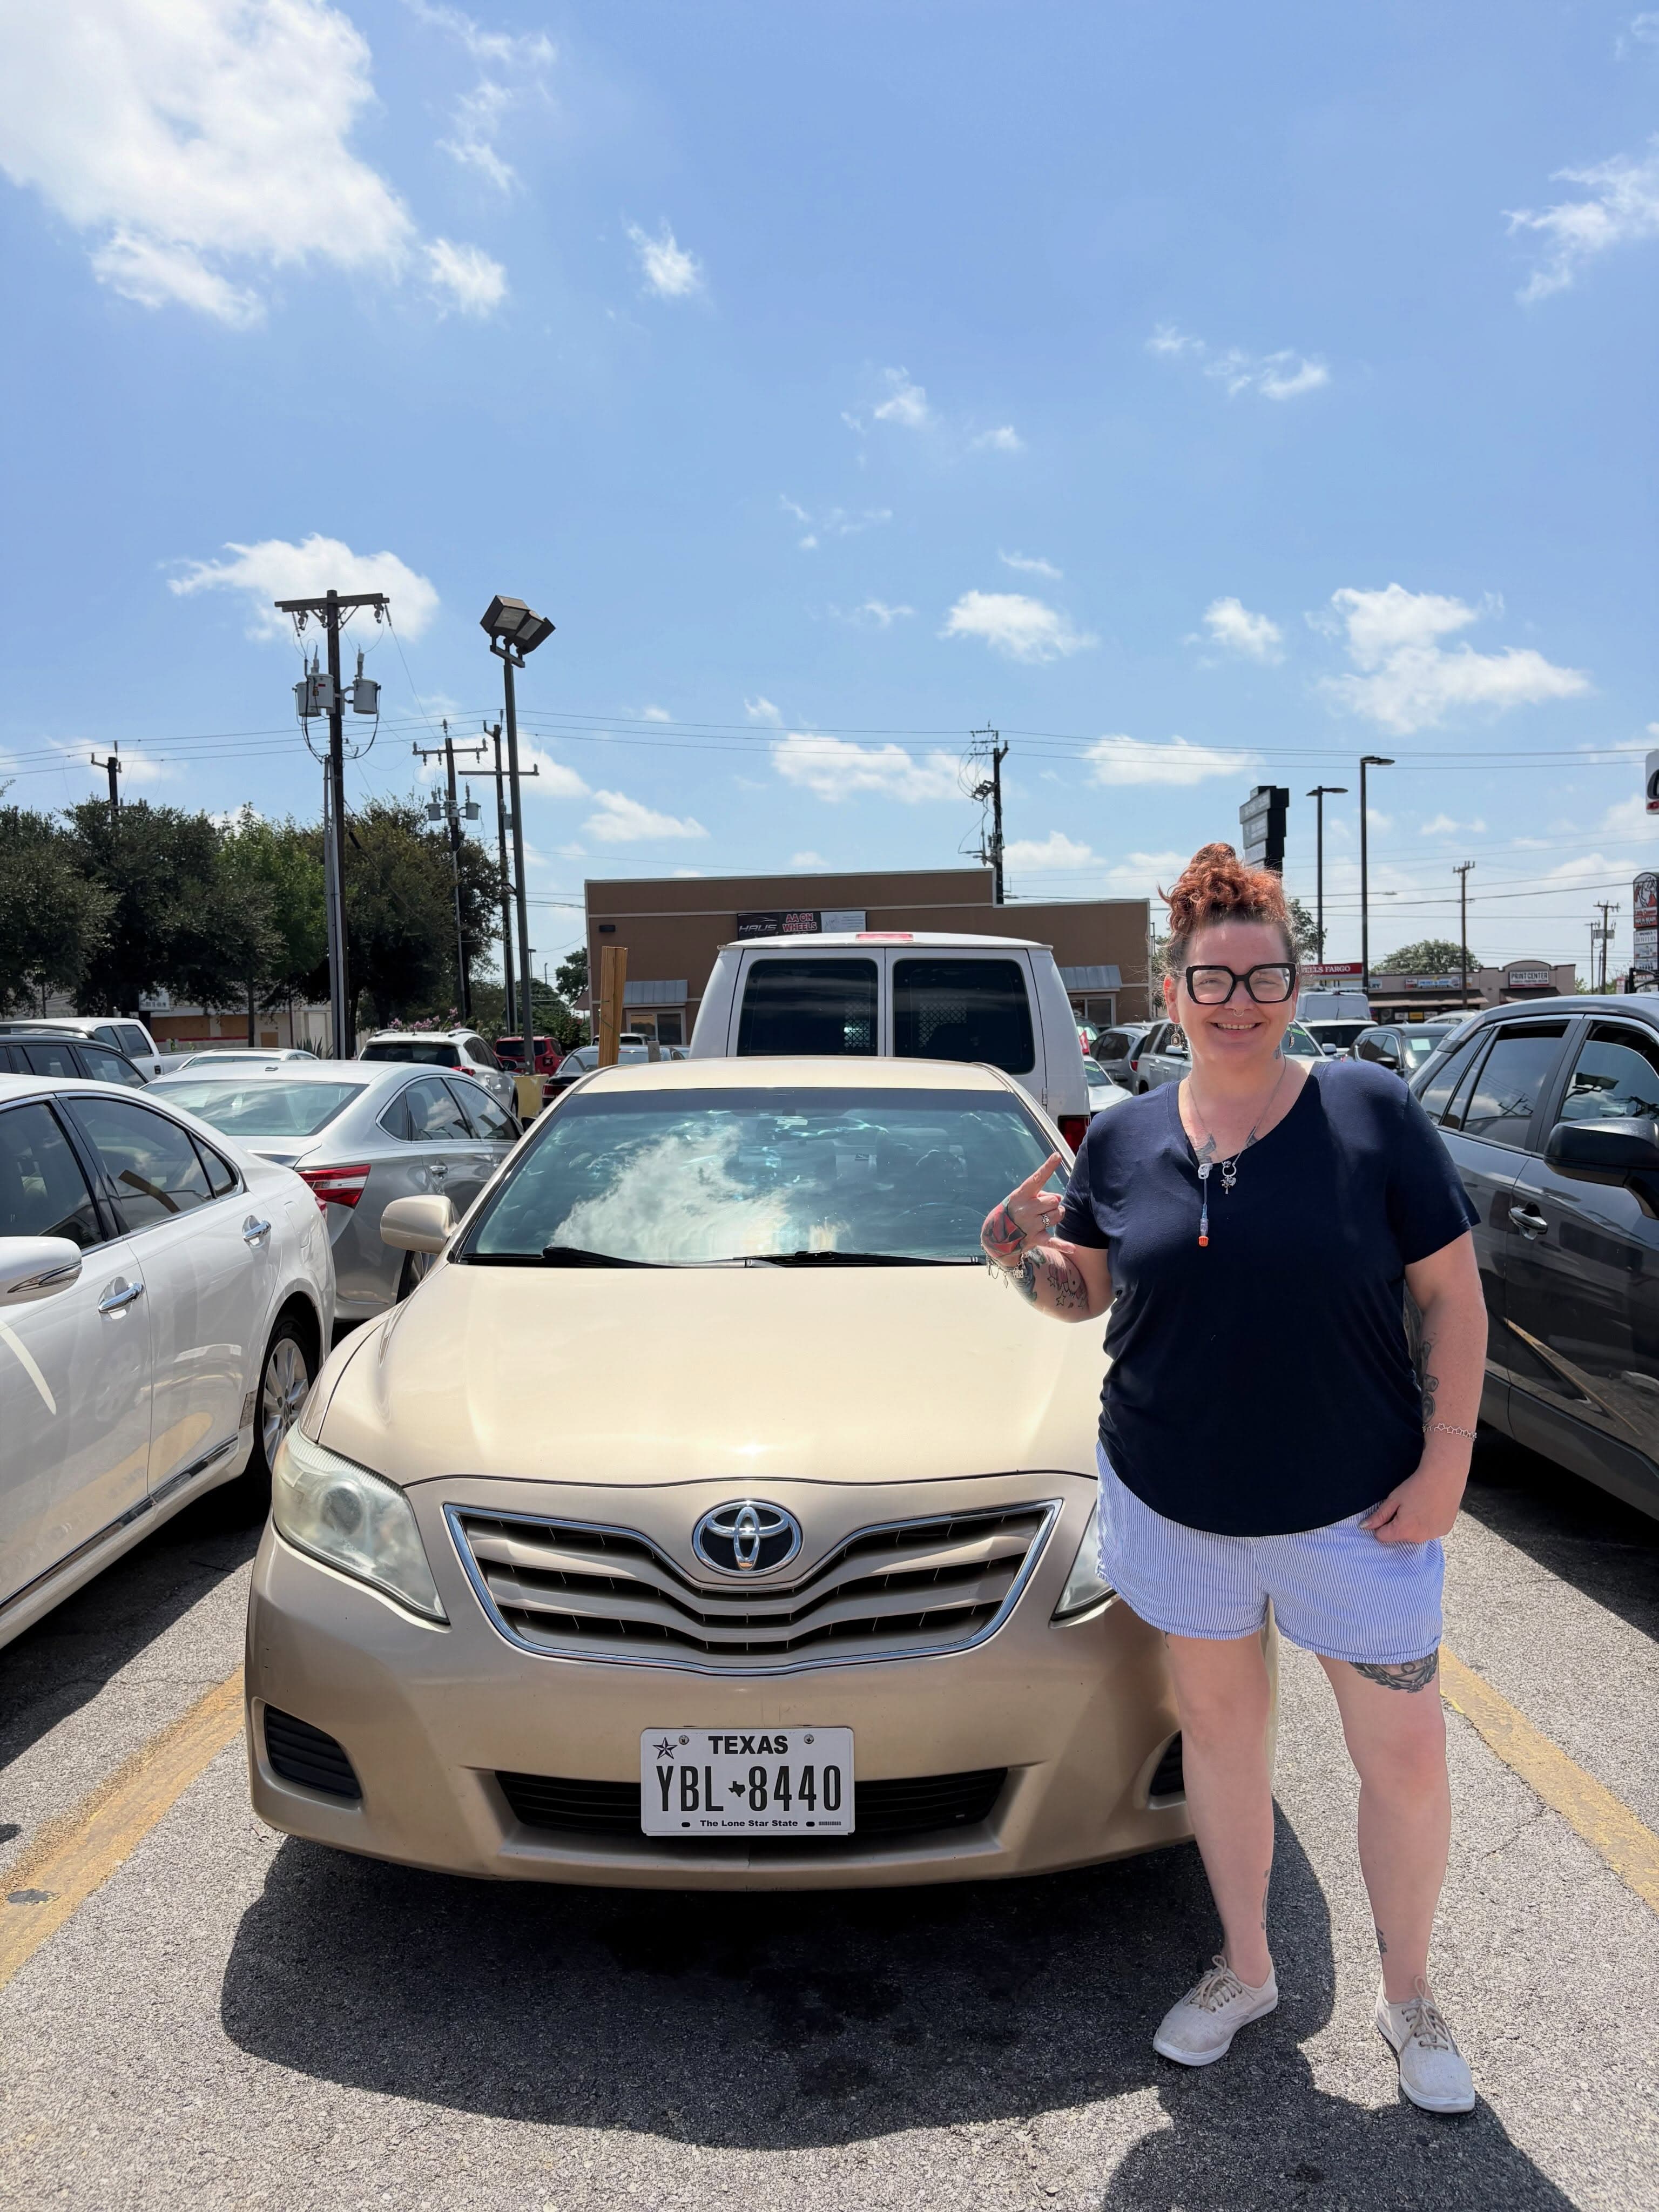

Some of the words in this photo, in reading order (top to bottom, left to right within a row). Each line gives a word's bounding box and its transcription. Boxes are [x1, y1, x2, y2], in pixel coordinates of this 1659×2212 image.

[786, 914, 799, 923] AA
[800, 913, 813, 922] ON
[739, 924, 777, 932] HAUS
[783, 922, 817, 932] WHEELS
[708, 1735, 788, 1755] TEXAS
[656, 1765, 724, 1812] YBL
[748, 1765, 841, 1811] 8440
